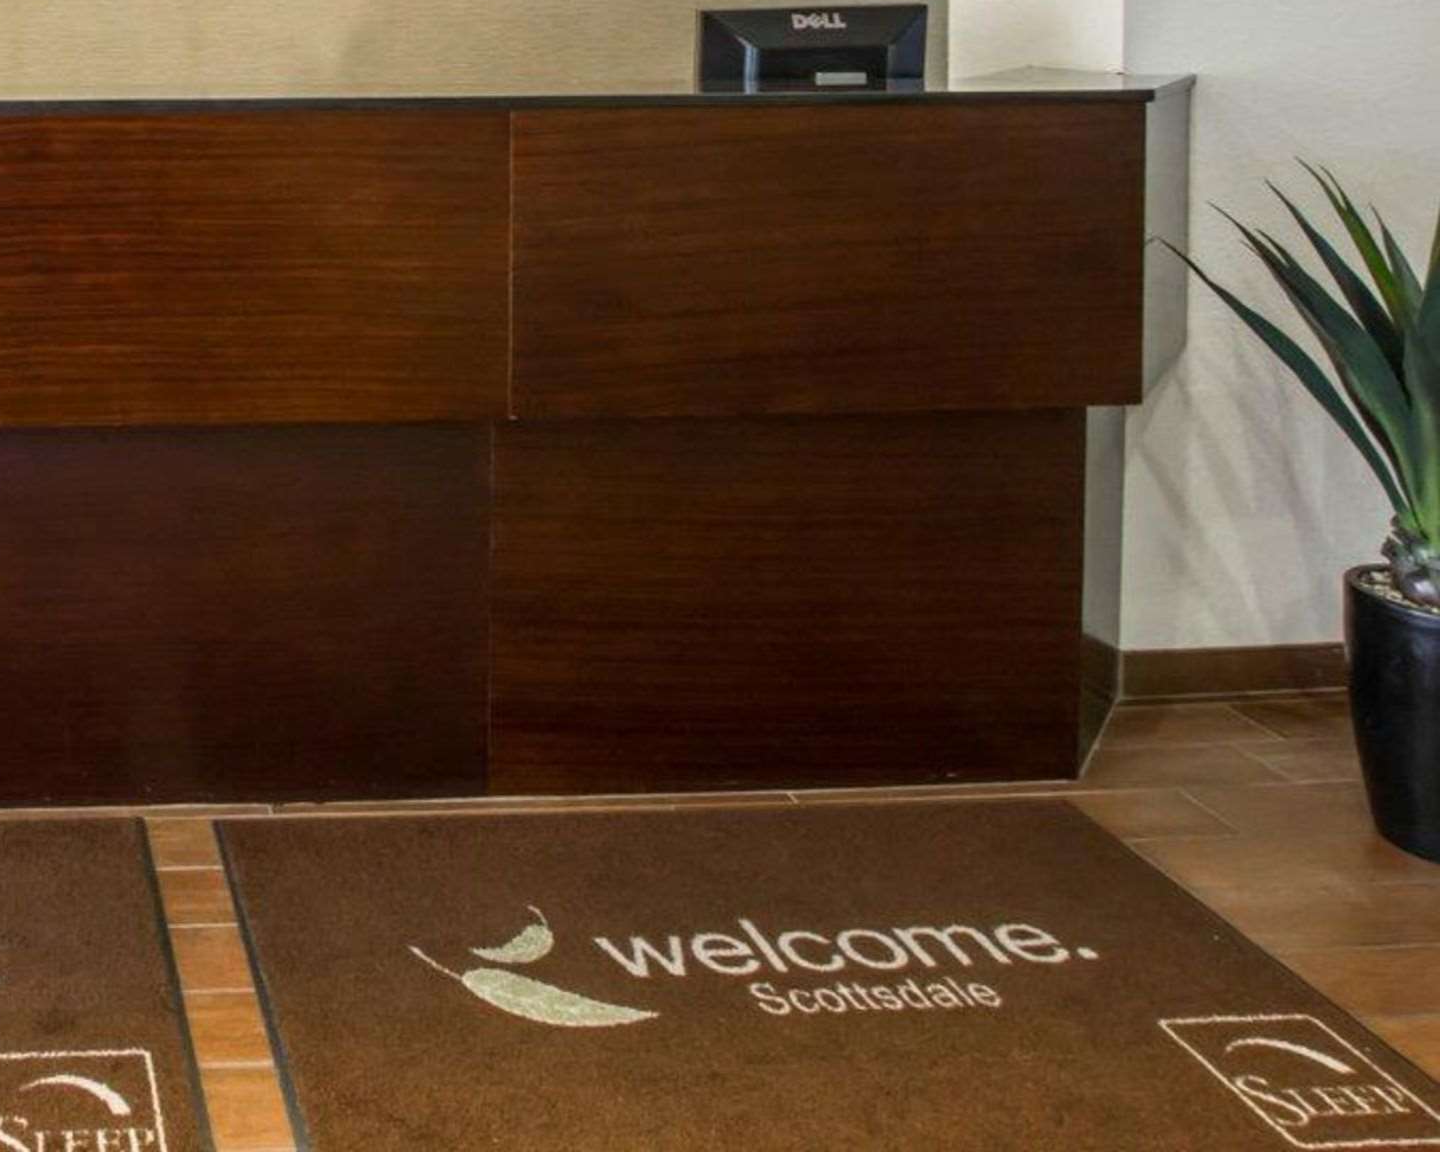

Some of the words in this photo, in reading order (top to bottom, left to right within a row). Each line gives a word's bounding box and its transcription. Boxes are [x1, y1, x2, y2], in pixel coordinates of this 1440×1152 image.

[791, 12, 847, 29] DELL
[594, 919, 1100, 978] welcome.
[749, 976, 1003, 1016] Scottsdale
[1235, 1074, 1412, 1127] SLEEP
